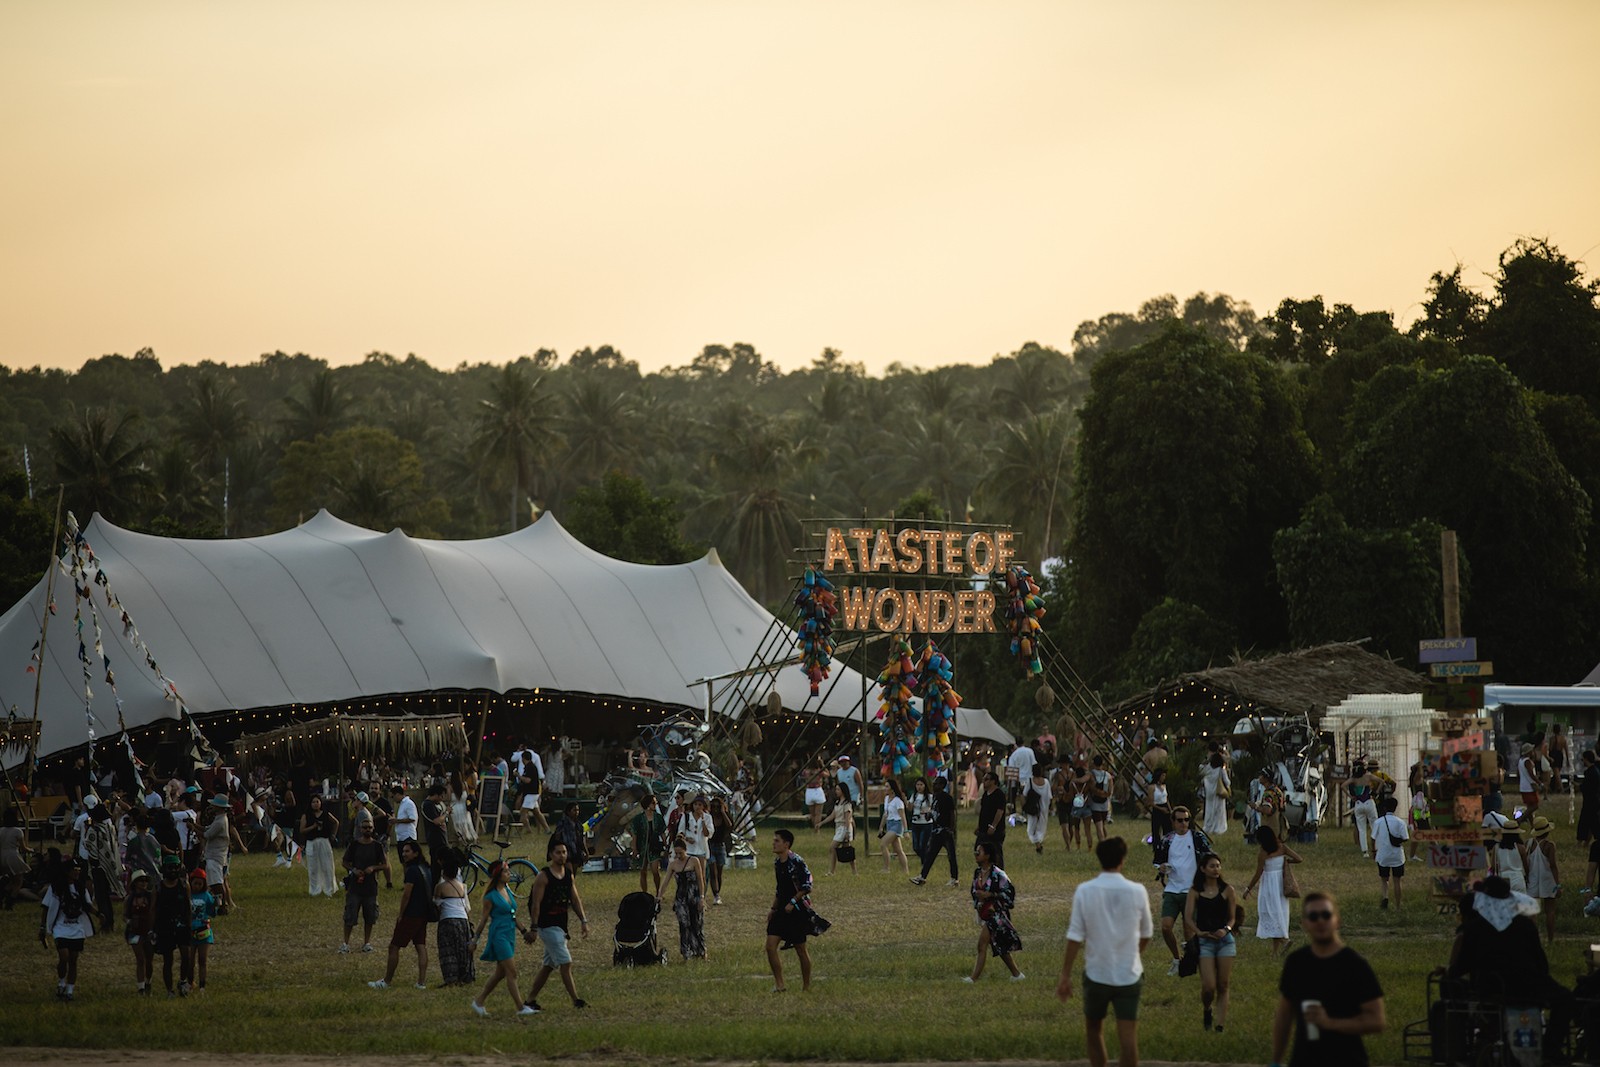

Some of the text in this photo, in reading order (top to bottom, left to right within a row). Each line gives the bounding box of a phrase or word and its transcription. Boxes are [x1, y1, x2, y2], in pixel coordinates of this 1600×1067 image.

[823, 527, 1015, 575] A TASTE OF
[841, 586, 997, 633] WONDER
[1420, 639, 1467, 650] EMERGENCY
[1429, 846, 1479, 867] Toilet
